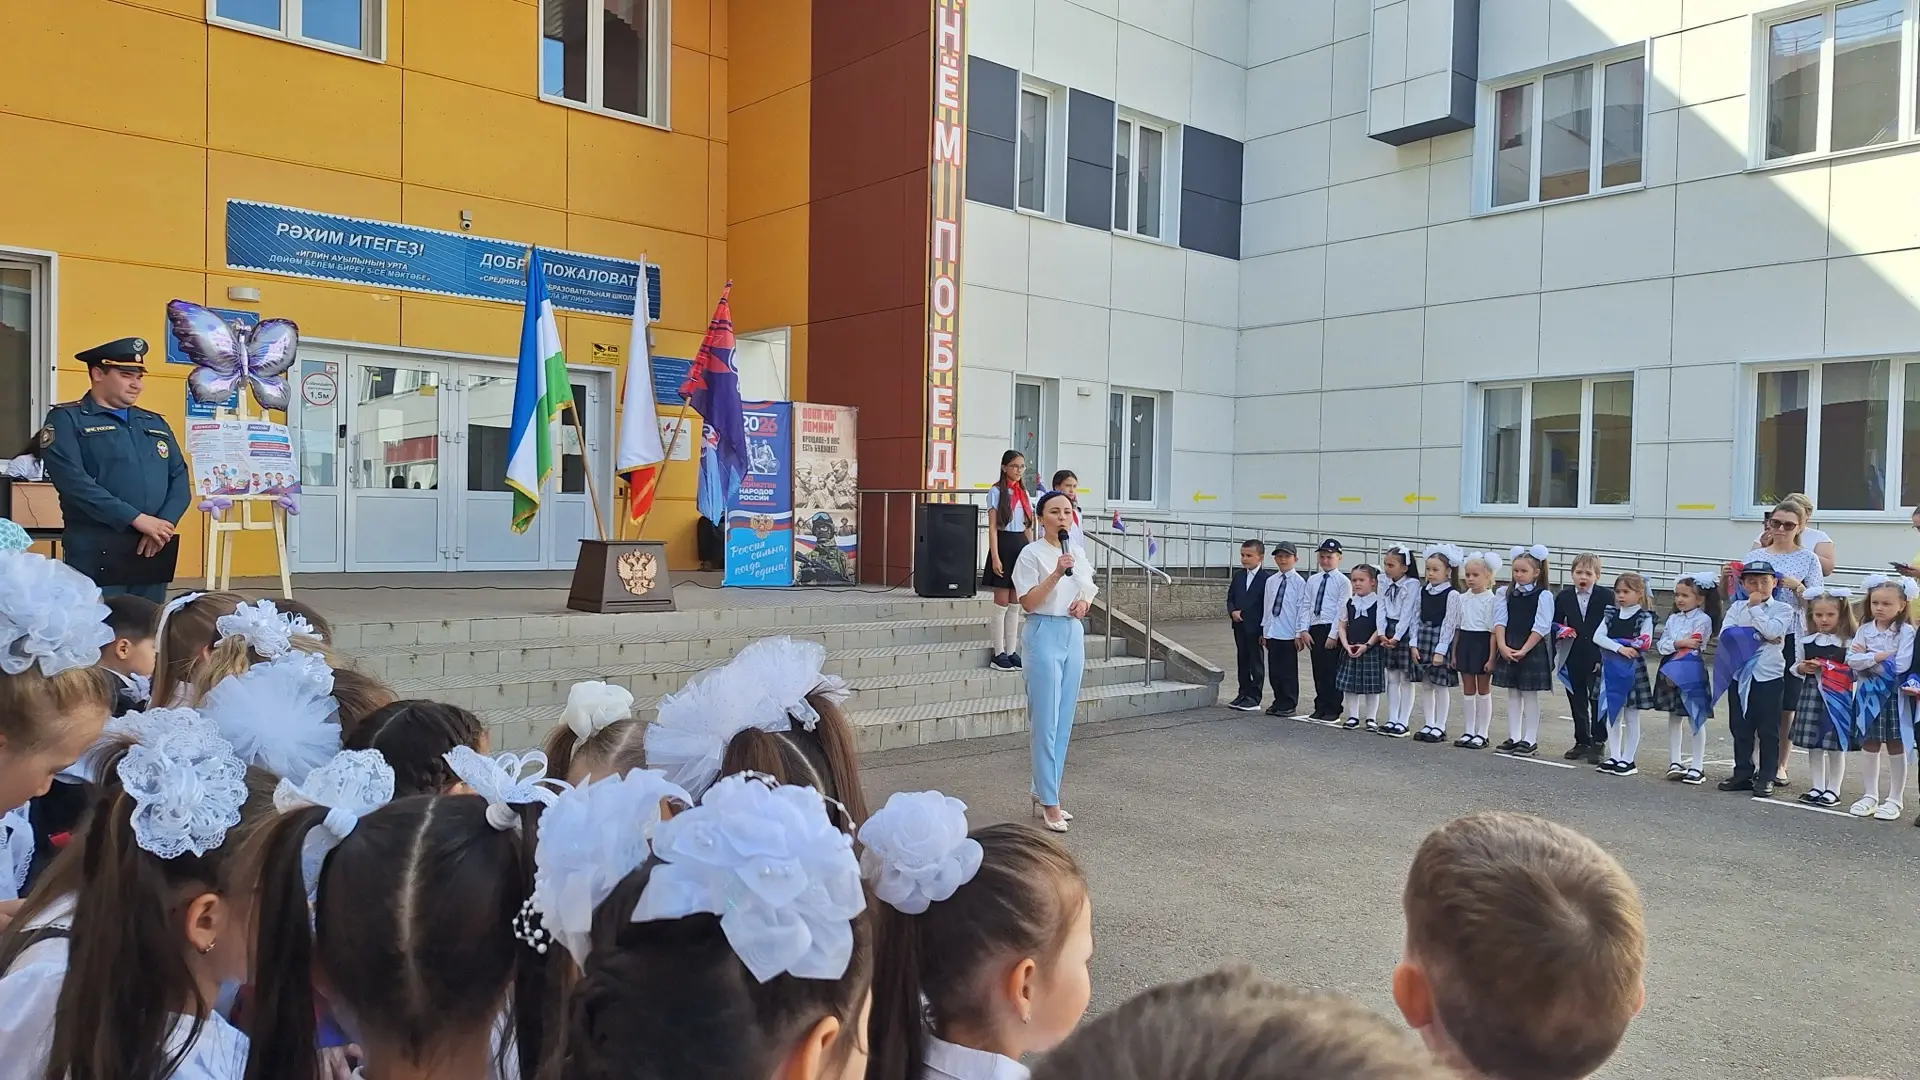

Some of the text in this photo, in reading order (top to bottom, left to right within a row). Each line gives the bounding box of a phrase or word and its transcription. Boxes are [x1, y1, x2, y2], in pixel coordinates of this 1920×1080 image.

[935, 0, 966, 167] НЁМ
[276, 222, 344, 245] РӘХИМ
[295, 249, 330, 261] «ИГЛИН
[387, 261, 408, 271] УРТА
[479, 253, 528, 270] ДОБР
[367, 268, 386, 276] 5-СЕ
[479, 275, 520, 286] «СРЕДНЯЯ
[611, 293, 636, 301] ШКОЛА
[310, 391, 329, 400] 1,5м
[739, 487, 774, 496] НАРОДОВ
[730, 541, 765, 557] Россия
[734, 561, 761, 576] когда
[755, 557, 788, 580] едина!
